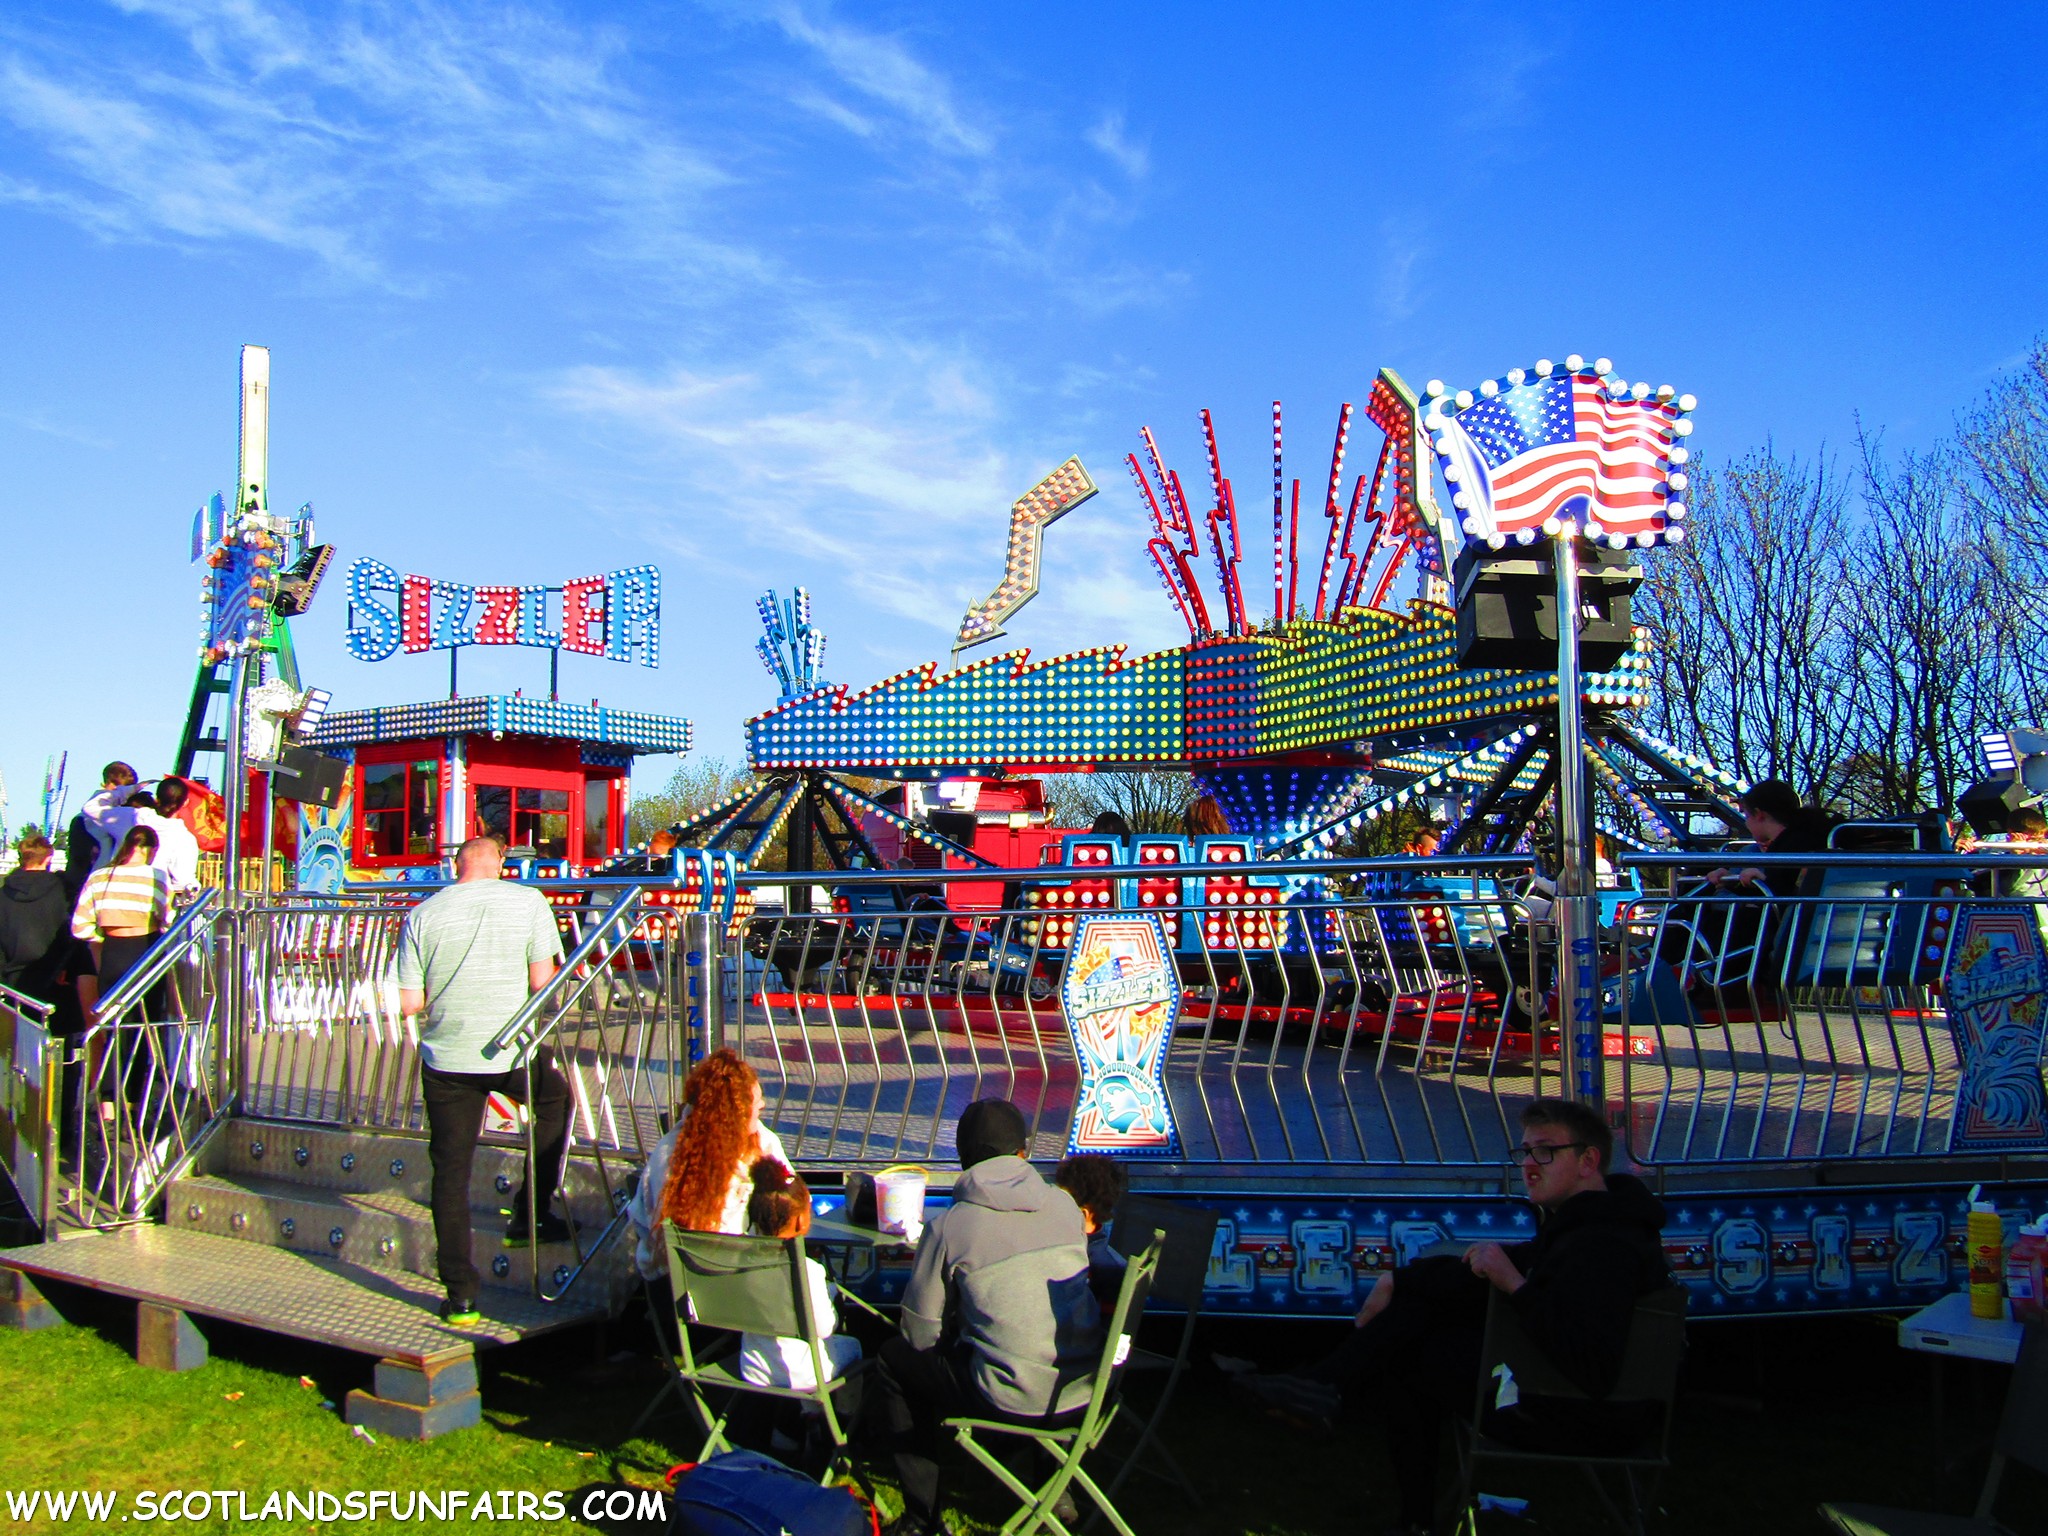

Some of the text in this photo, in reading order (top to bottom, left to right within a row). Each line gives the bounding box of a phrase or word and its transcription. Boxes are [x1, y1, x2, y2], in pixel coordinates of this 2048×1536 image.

[345, 556, 660, 669] SIZZLER
[1071, 969, 1171, 1020] SIZZLER
[1950, 960, 2042, 1011] SIZZLER
